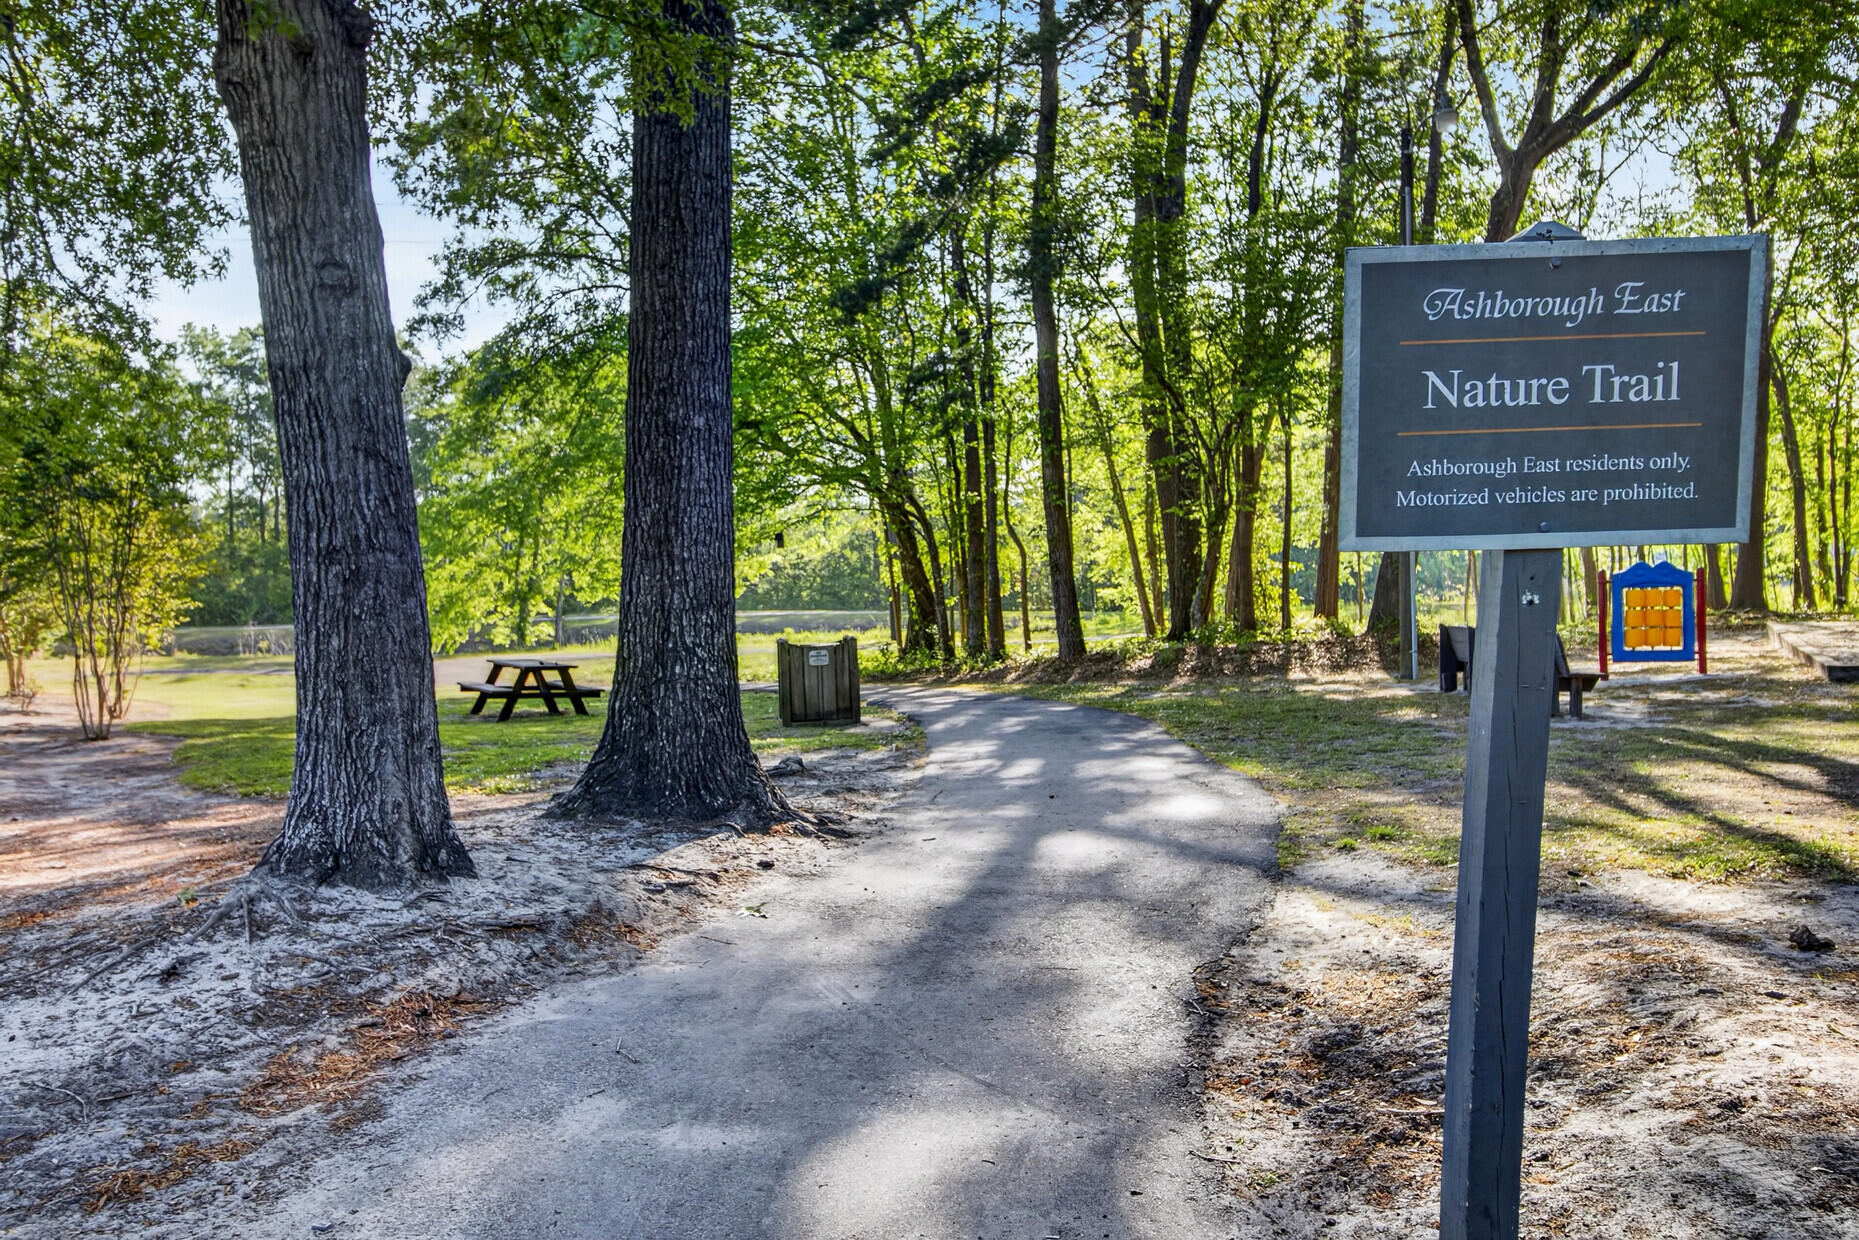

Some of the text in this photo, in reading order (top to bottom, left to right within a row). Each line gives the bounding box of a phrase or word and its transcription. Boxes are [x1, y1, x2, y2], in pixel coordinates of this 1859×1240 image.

[1422, 281, 1686, 328] Ashborough East
[1421, 360, 1682, 410] Nature Trail
[1407, 452, 1692, 479] Ashborough East residents only.
[1396, 482, 1699, 507] Motorized vehicles are prohibited.
